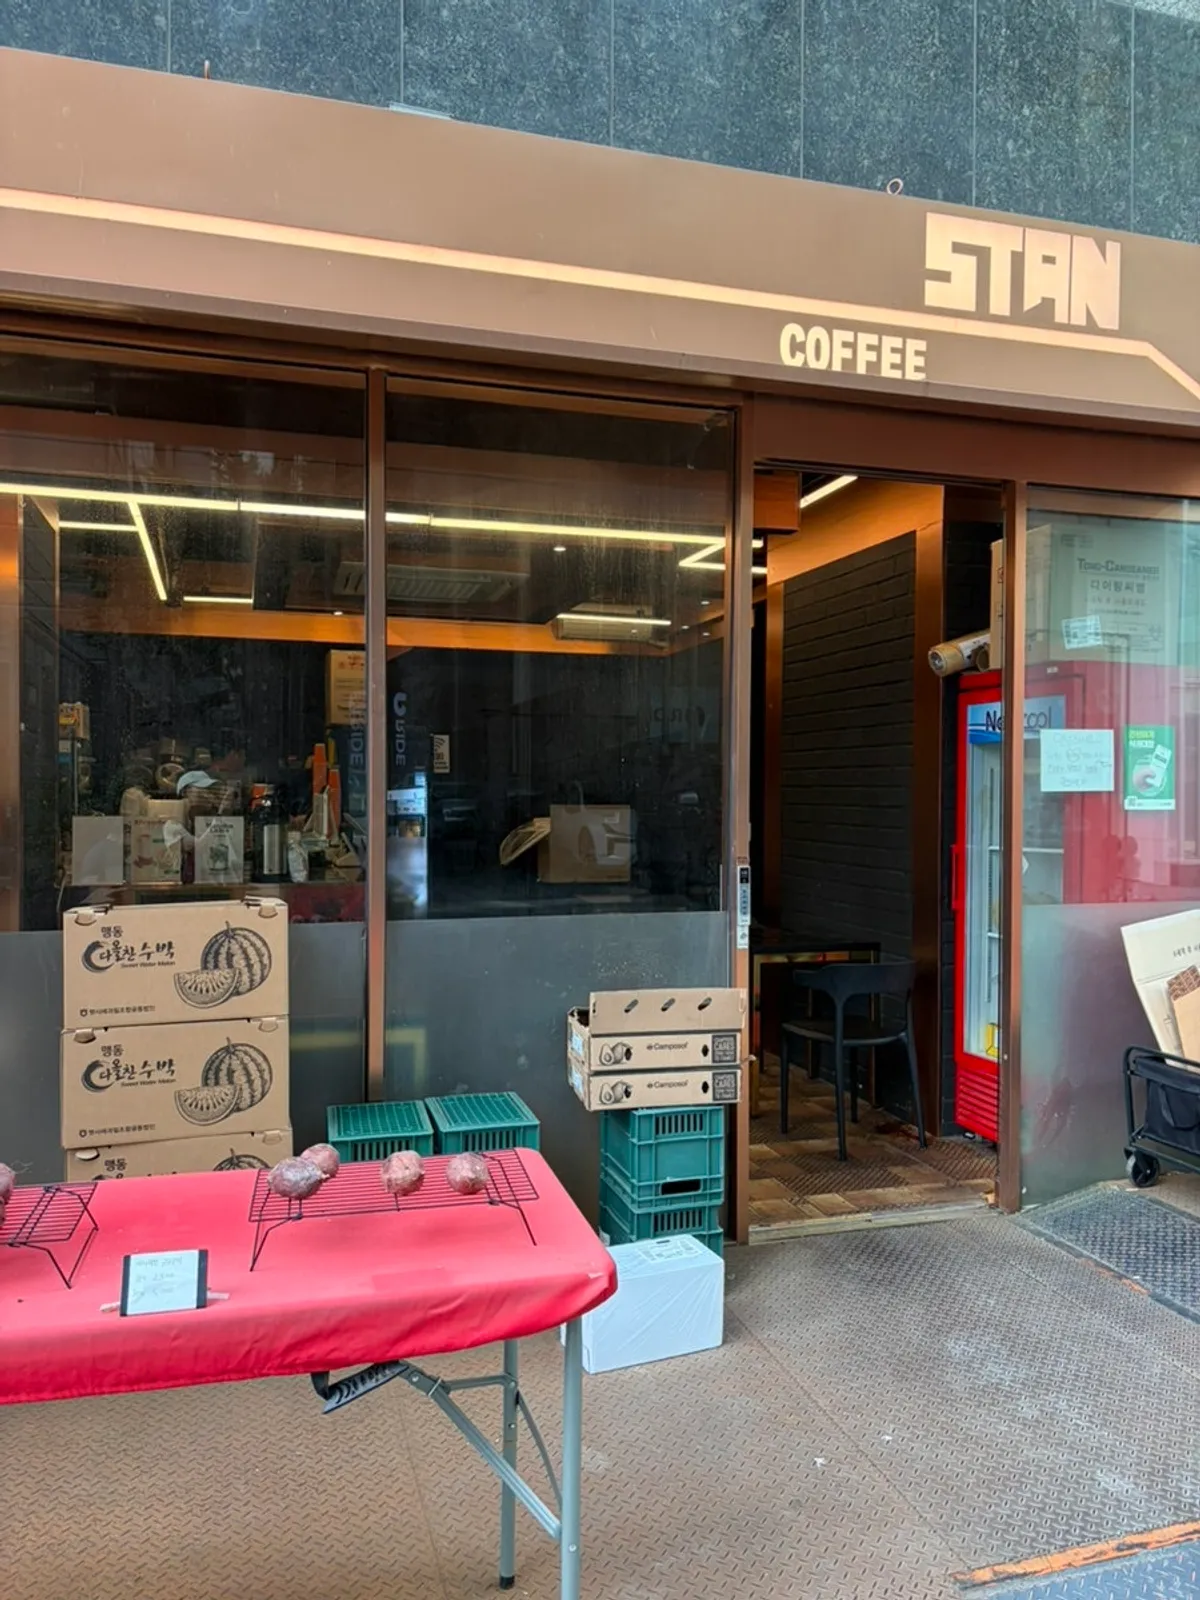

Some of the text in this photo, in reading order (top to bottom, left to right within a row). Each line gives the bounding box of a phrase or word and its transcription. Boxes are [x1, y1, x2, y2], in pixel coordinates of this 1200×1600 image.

[924, 212, 1121, 331] STAN
[779, 322, 927, 380] COFFEE
[139, 940, 175, 960] 수박
[139, 1058, 175, 1079] 수박
